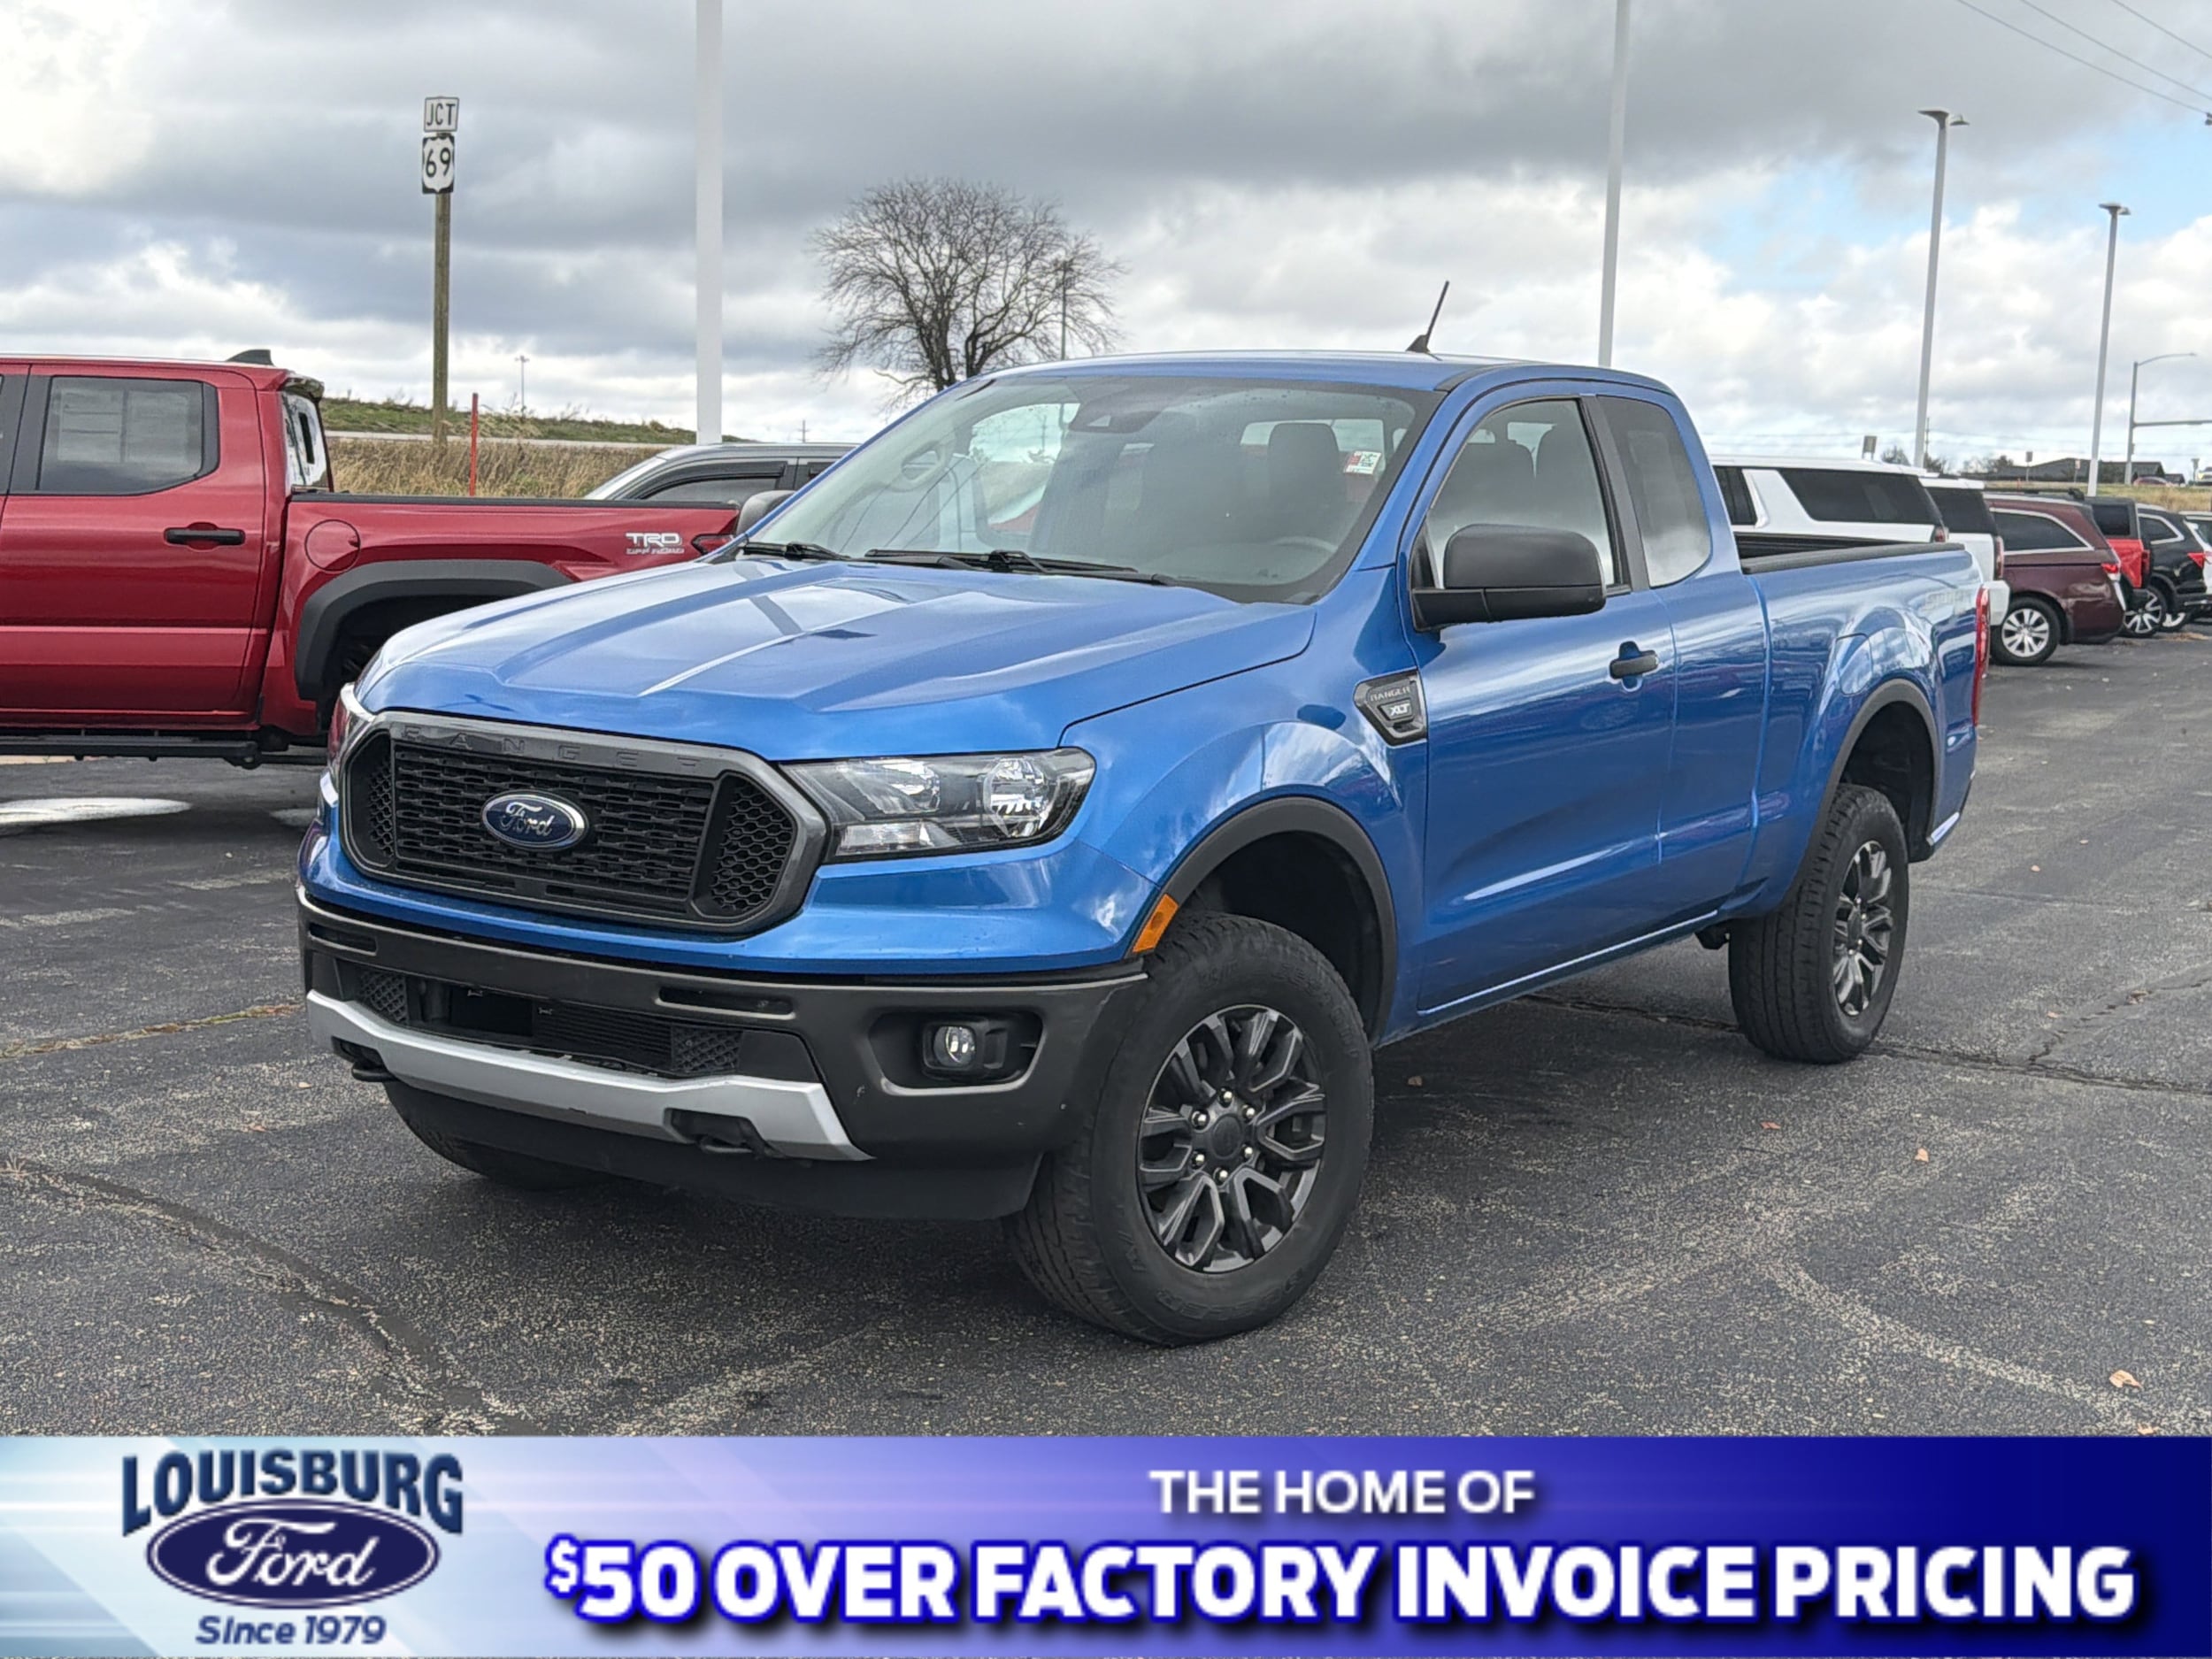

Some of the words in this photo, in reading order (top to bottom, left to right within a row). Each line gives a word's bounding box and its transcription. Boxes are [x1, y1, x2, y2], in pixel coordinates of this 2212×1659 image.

[426, 103, 456, 126] JCT
[426, 148, 451, 178] 69
[626, 533, 680, 547] TRD
[1370, 686, 1411, 702] RANGER
[1390, 703, 1410, 716] XLT
[499, 801, 555, 836] Ford
